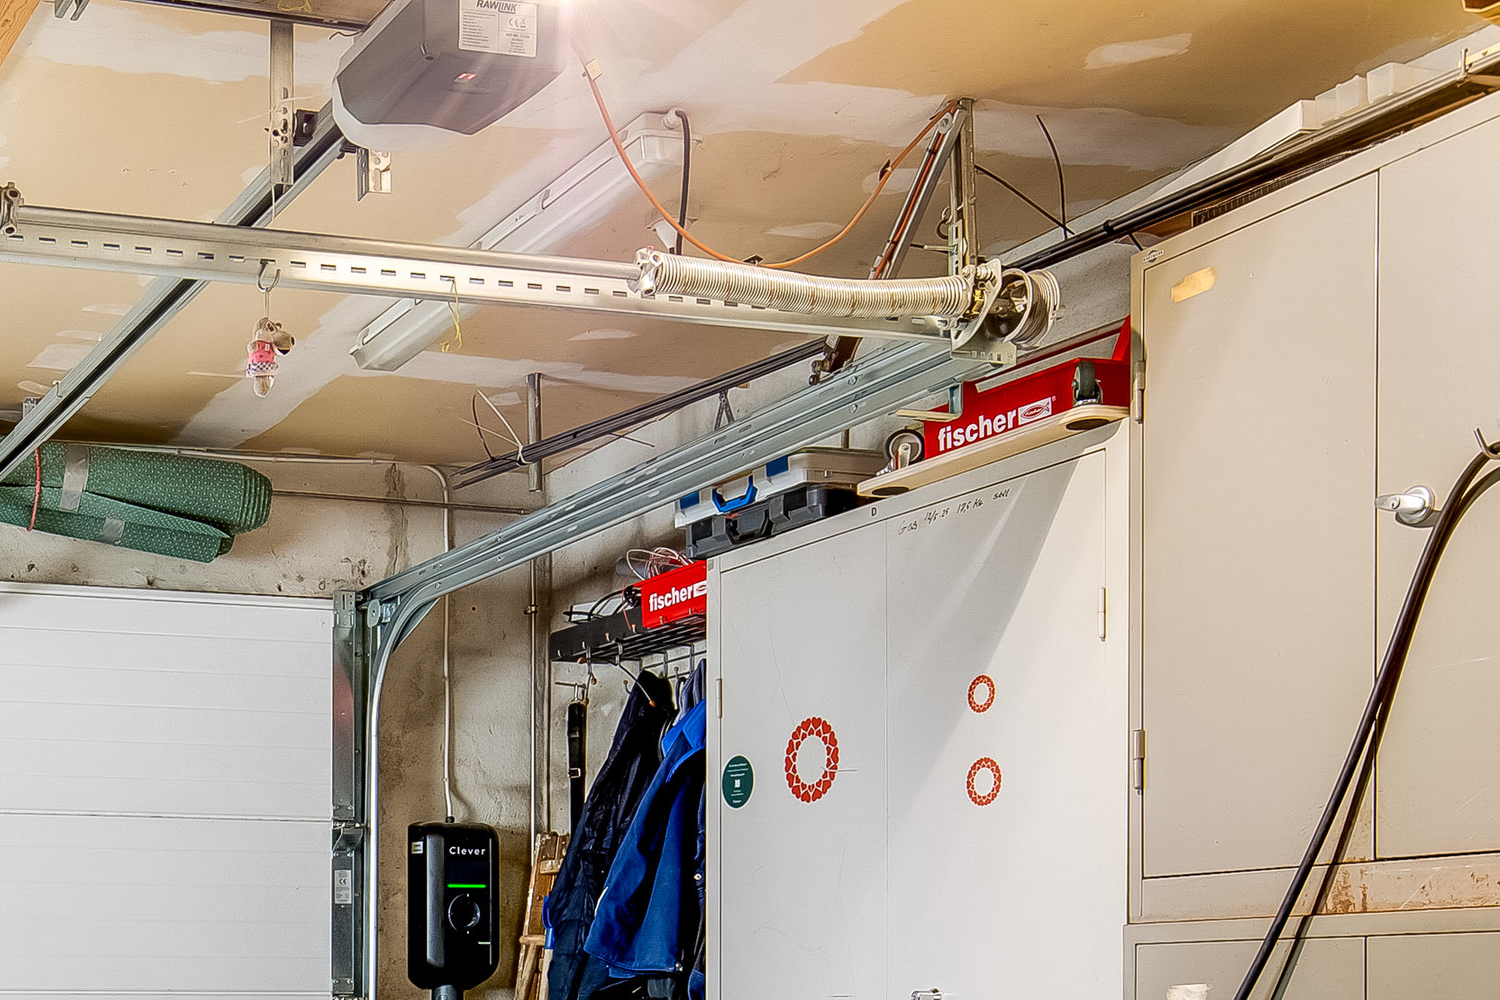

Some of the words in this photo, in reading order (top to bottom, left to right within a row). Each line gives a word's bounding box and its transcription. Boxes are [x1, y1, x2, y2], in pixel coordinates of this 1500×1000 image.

[476, 0, 517, 14] RAWLINK
[938, 409, 1016, 451] fischer
[871, 507, 877, 516] D
[649, 586, 693, 612] fischer
[449, 846, 486, 855] Clever
